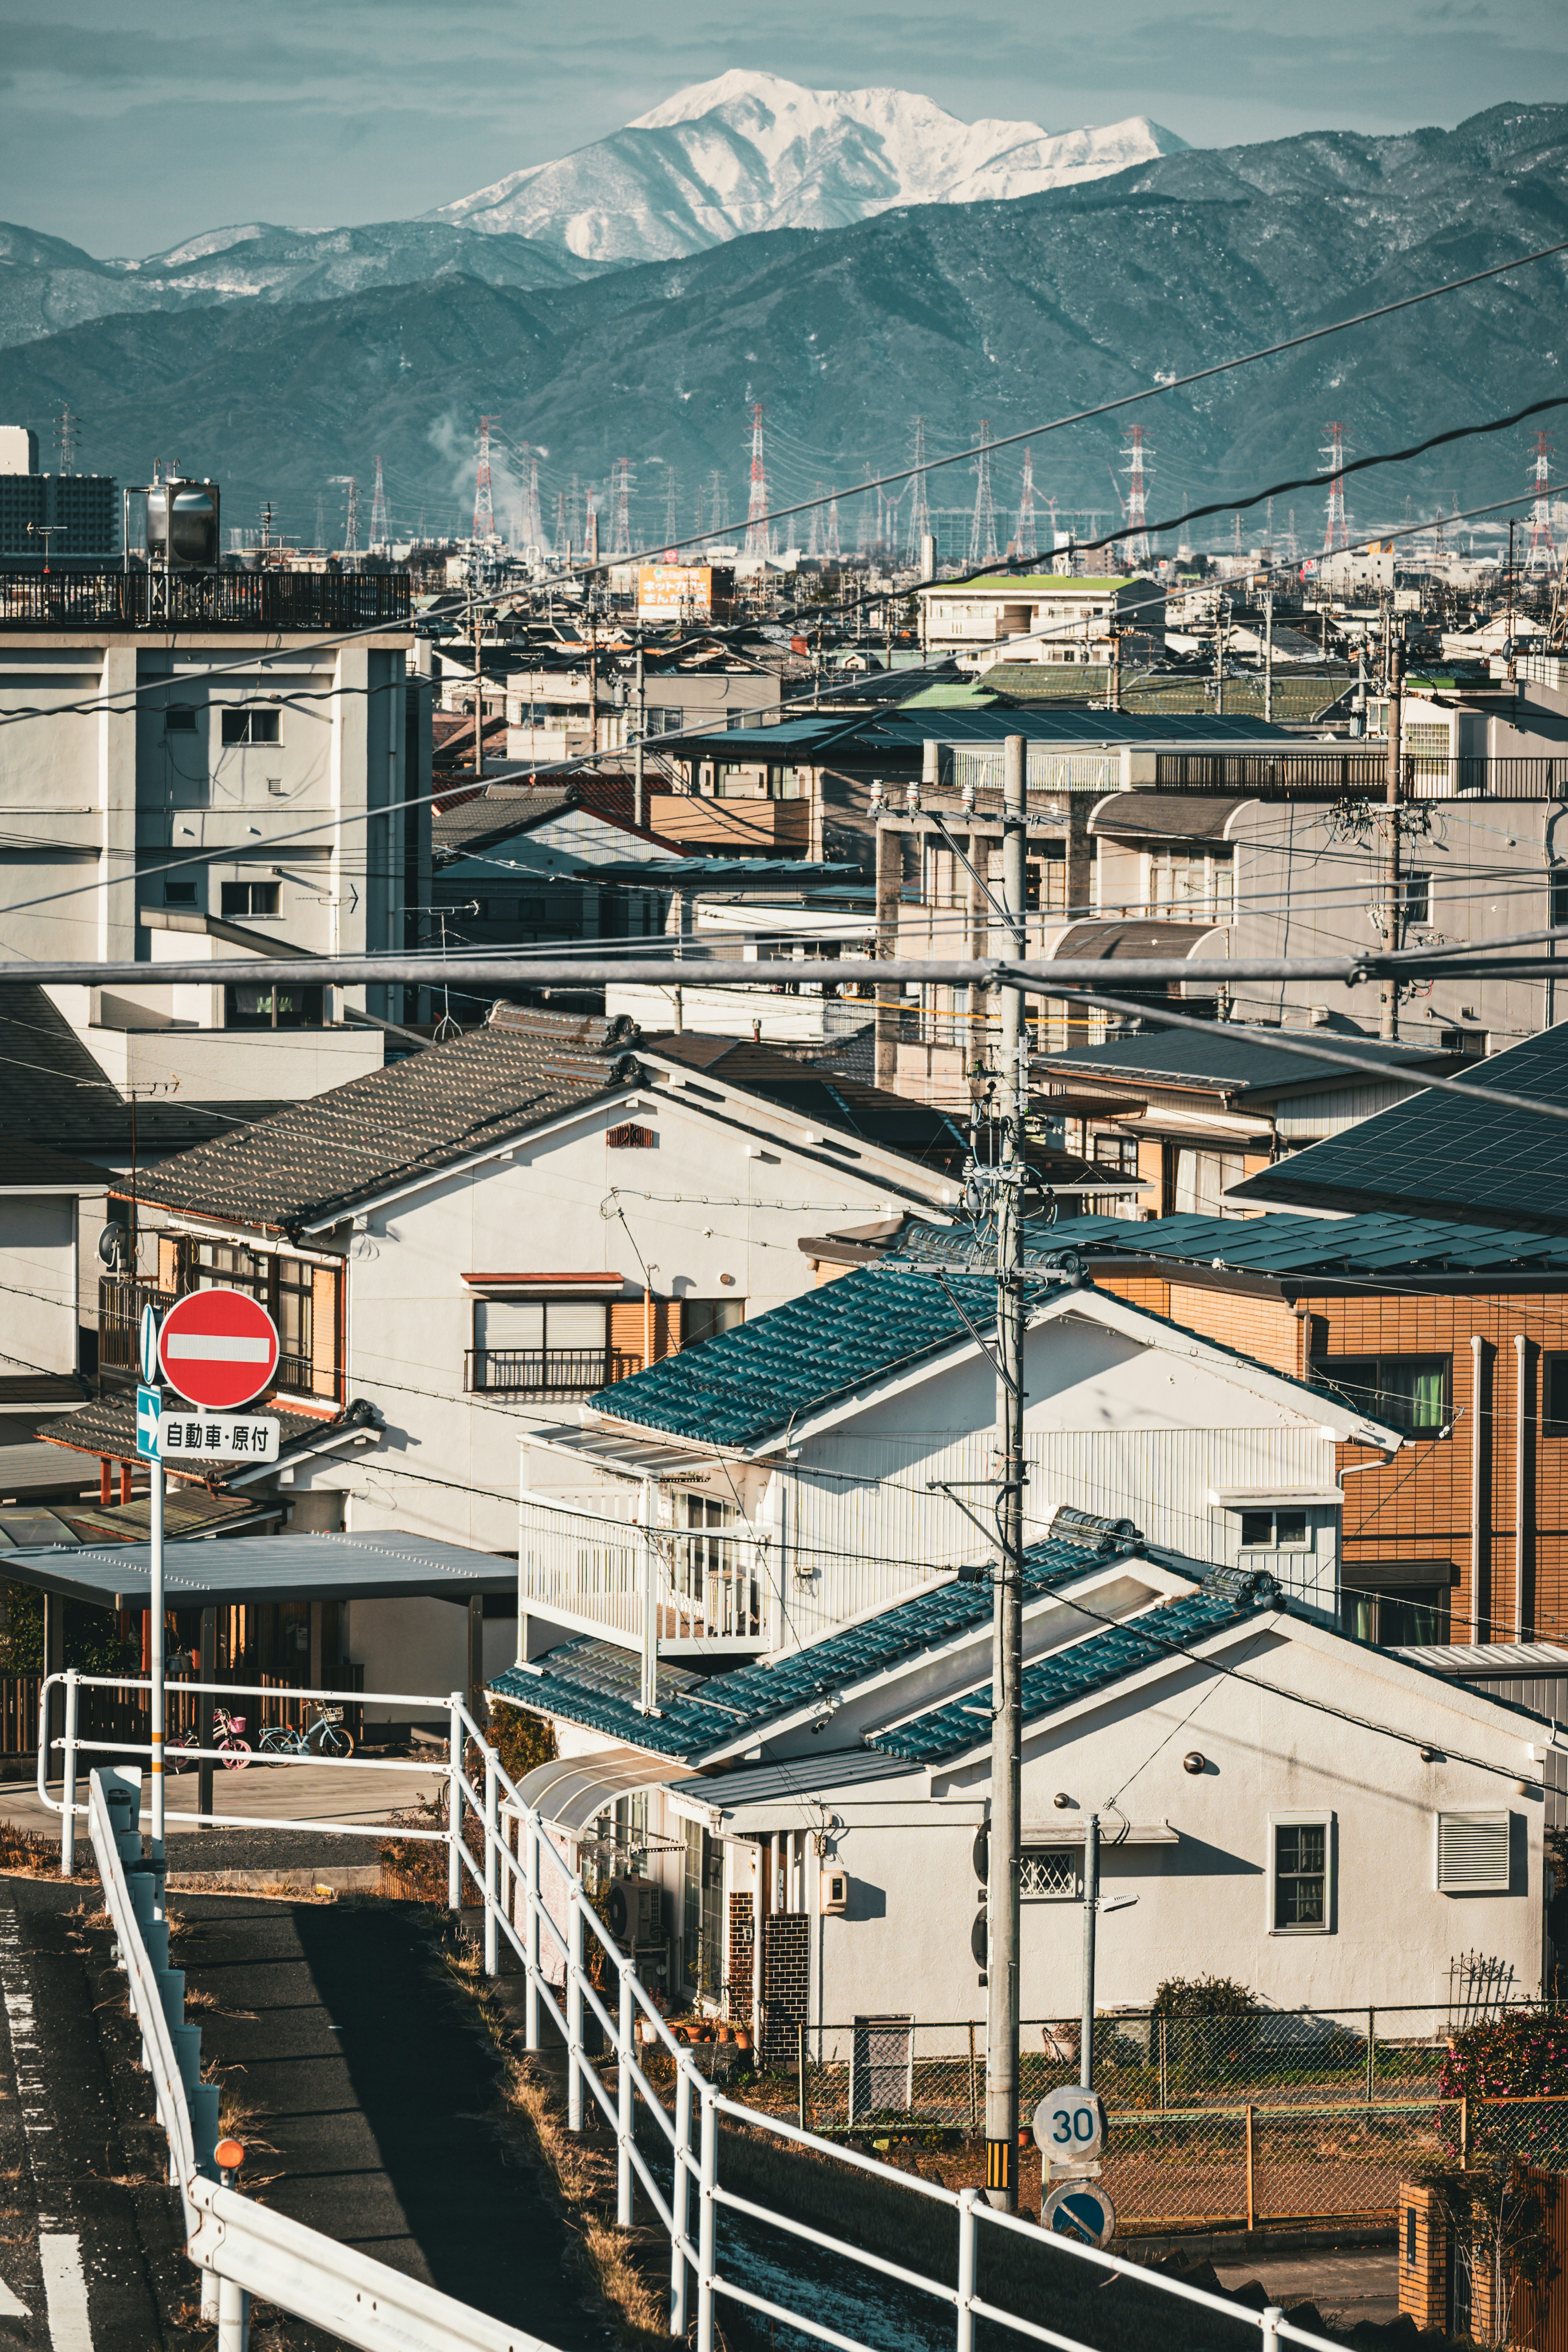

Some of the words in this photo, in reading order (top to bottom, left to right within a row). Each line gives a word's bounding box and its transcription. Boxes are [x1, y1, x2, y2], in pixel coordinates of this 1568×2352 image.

[644, 581, 707, 592] ネットカフェ
[167, 1422, 269, 1452] 自動車・原付
[1053, 2108, 1093, 2143] 30
